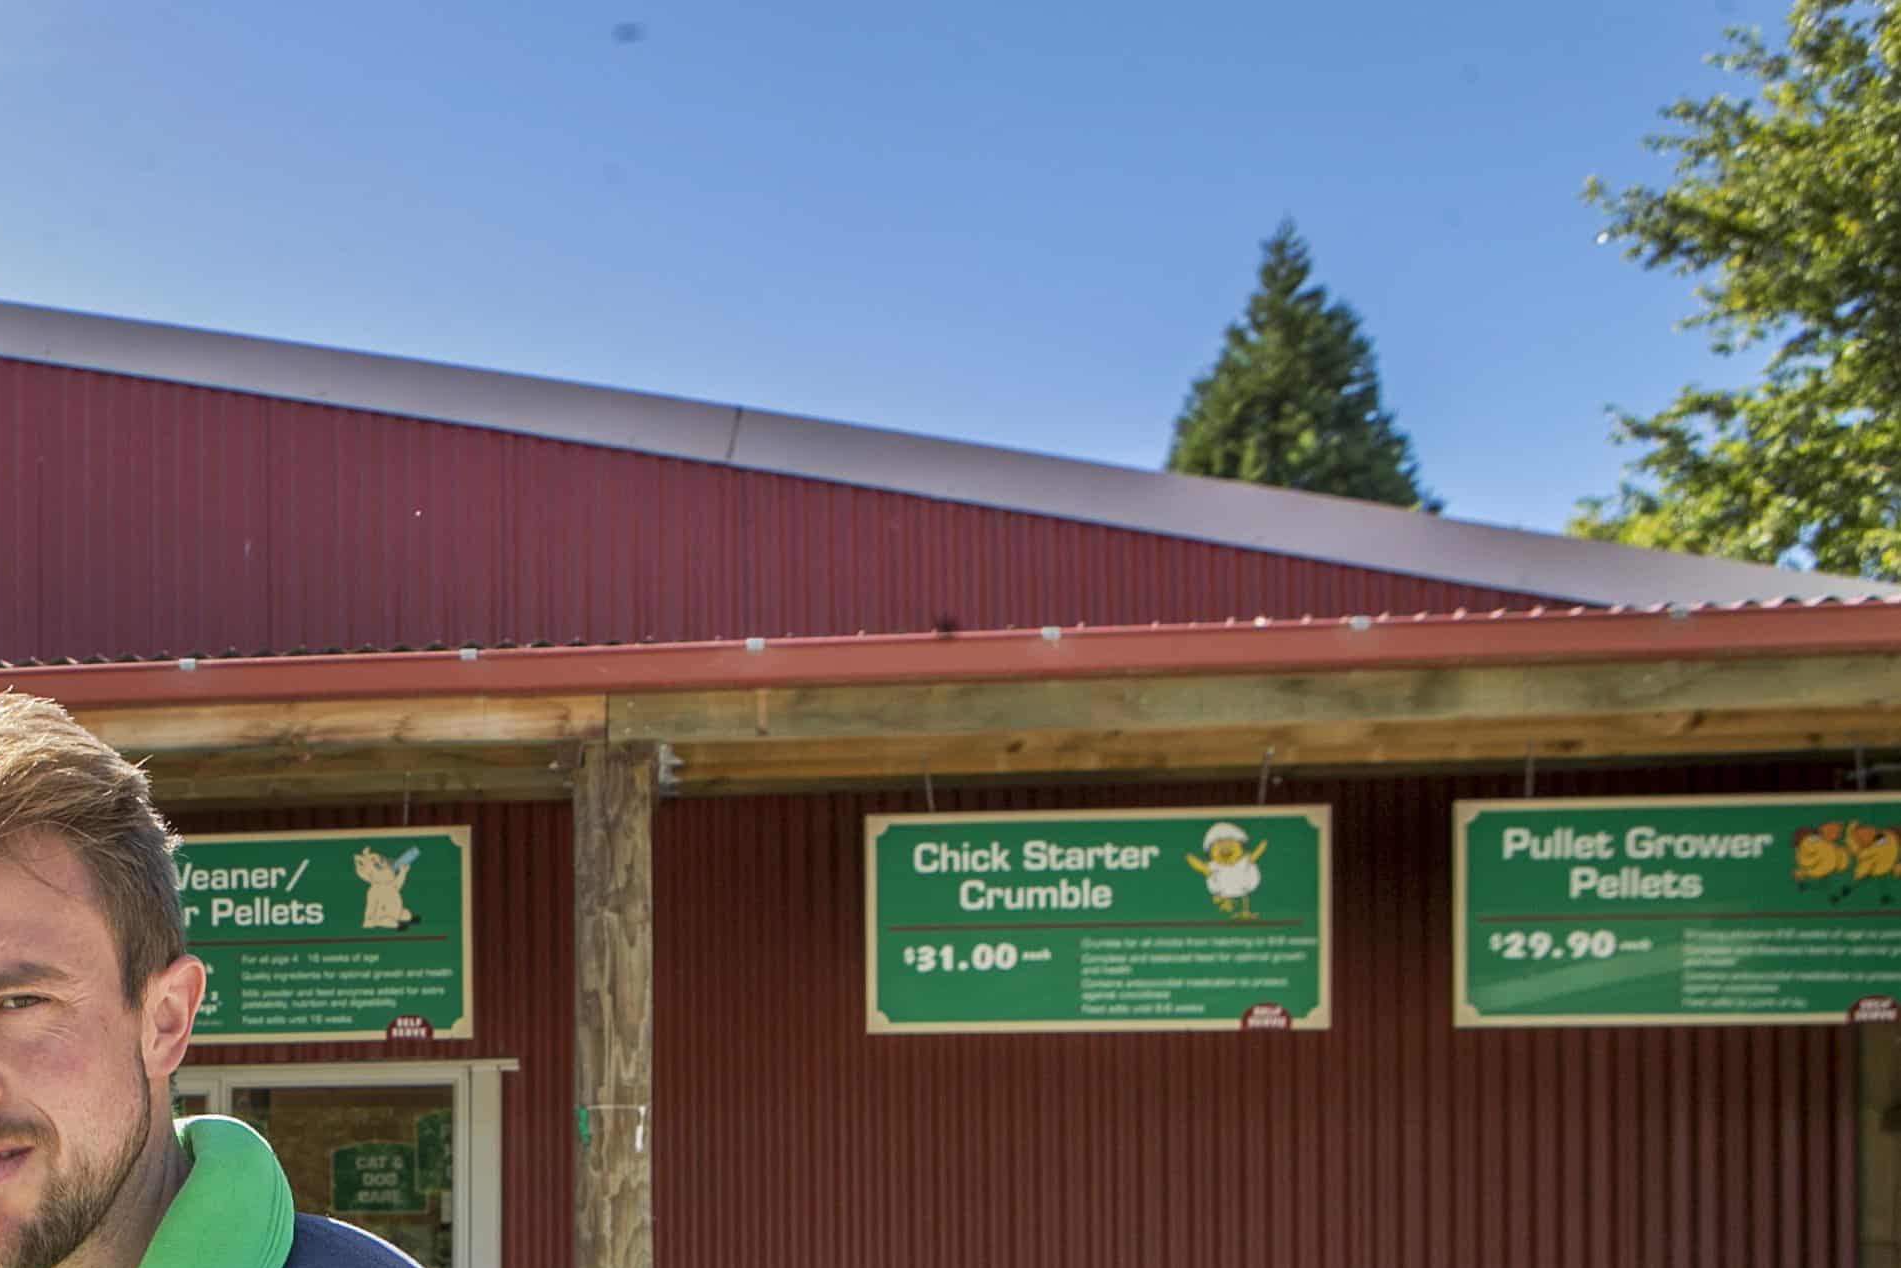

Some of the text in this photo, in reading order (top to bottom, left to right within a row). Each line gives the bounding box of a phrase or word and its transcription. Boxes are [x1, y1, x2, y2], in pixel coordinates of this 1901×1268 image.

[913, 840, 1159, 874] Chick Starter
[1502, 826, 1773, 859] Pullet Grower
[959, 879, 1112, 911] Crumble
[1569, 866, 1704, 899] Pellets
[211, 898, 324, 927] Pellets
[904, 942, 1018, 973] $31.00
[1489, 930, 1616, 960] $29.90
